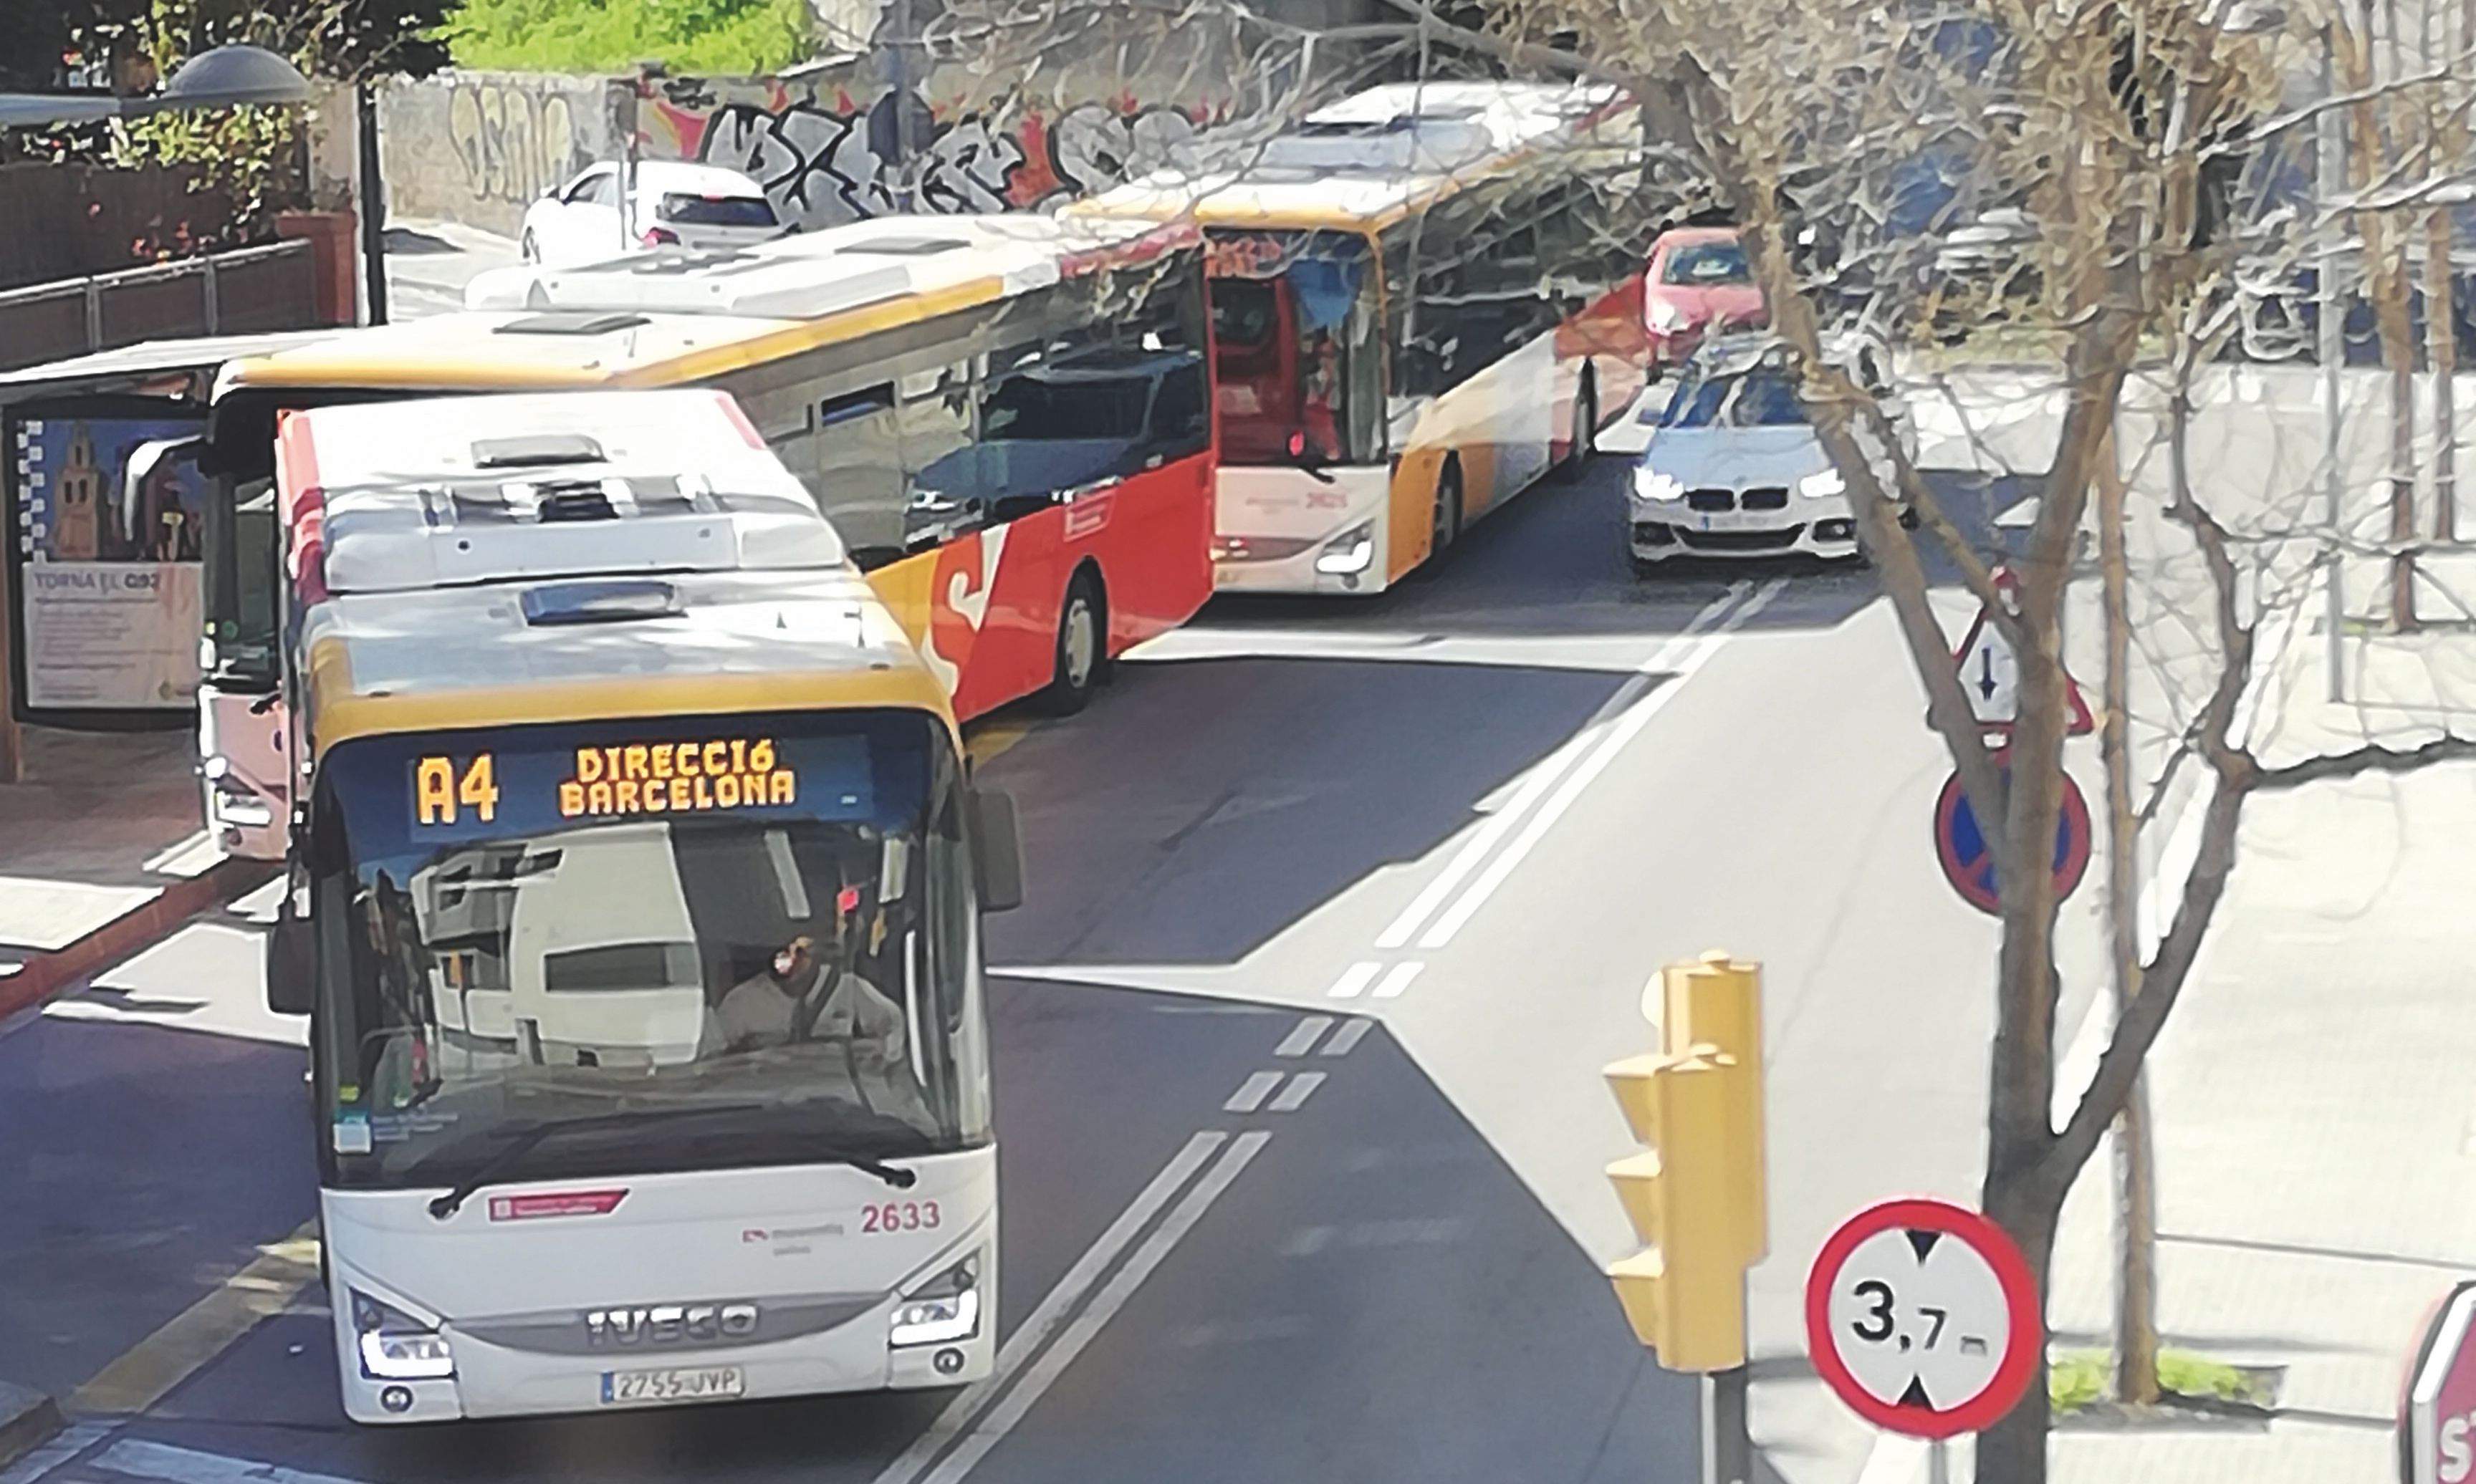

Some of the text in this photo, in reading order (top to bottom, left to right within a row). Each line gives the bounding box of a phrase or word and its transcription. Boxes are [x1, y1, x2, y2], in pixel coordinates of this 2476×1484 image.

[418, 753, 499, 825] A4
[559, 770, 795, 816] BARCELONA
[861, 1200, 941, 1233] 2633
[587, 1305, 757, 1347] IVECO
[619, 1372, 683, 1399] 2755
